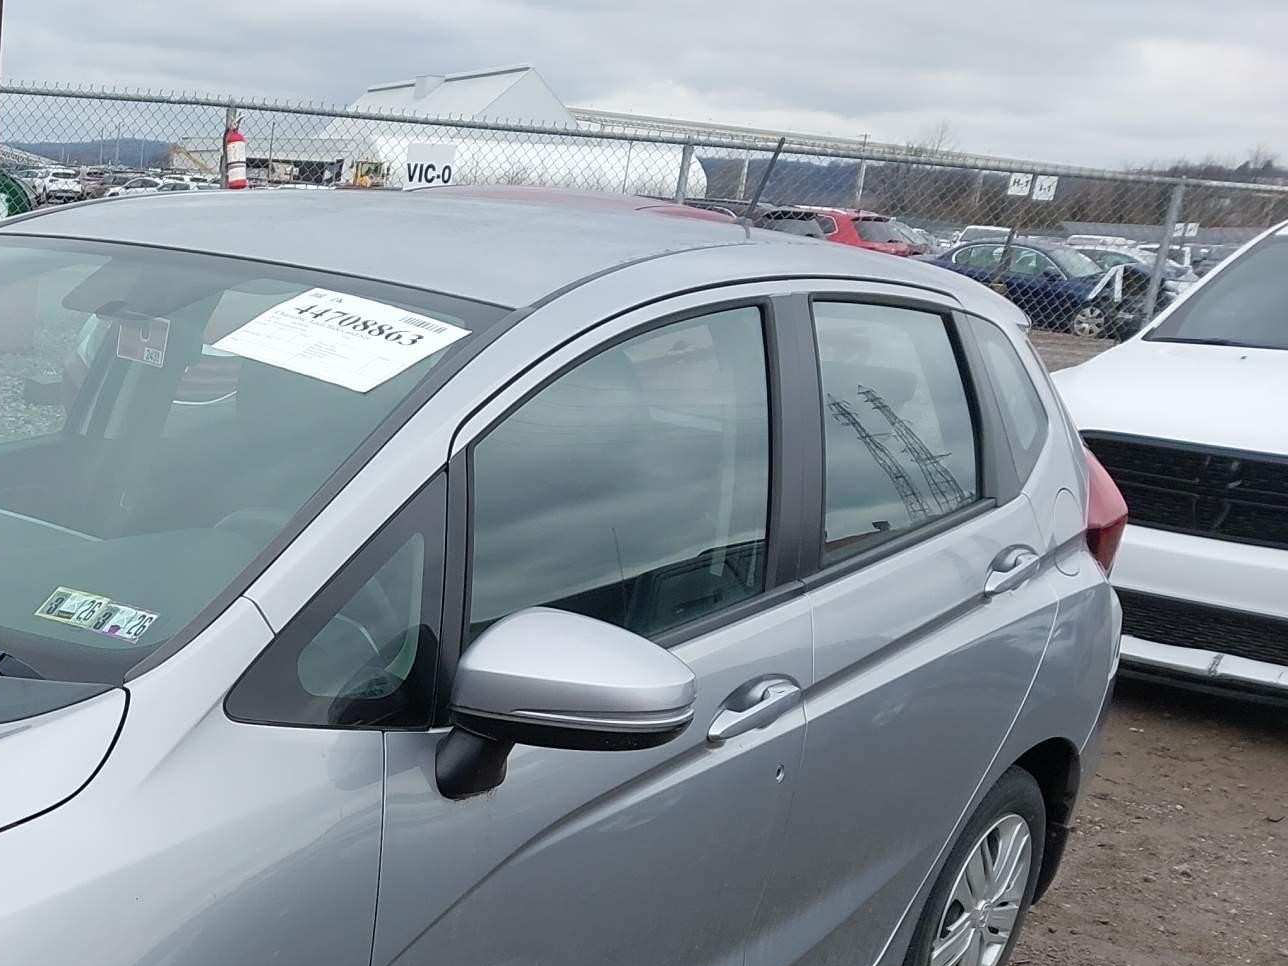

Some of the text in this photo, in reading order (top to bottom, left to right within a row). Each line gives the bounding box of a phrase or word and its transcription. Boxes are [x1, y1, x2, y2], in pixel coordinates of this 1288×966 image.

[295, 304, 425, 346] 44708863
[46, 597, 65, 615] 3
[76, 599, 103, 622] 26
[93, 612, 113, 630] 3
[126, 615, 154, 637] 26
